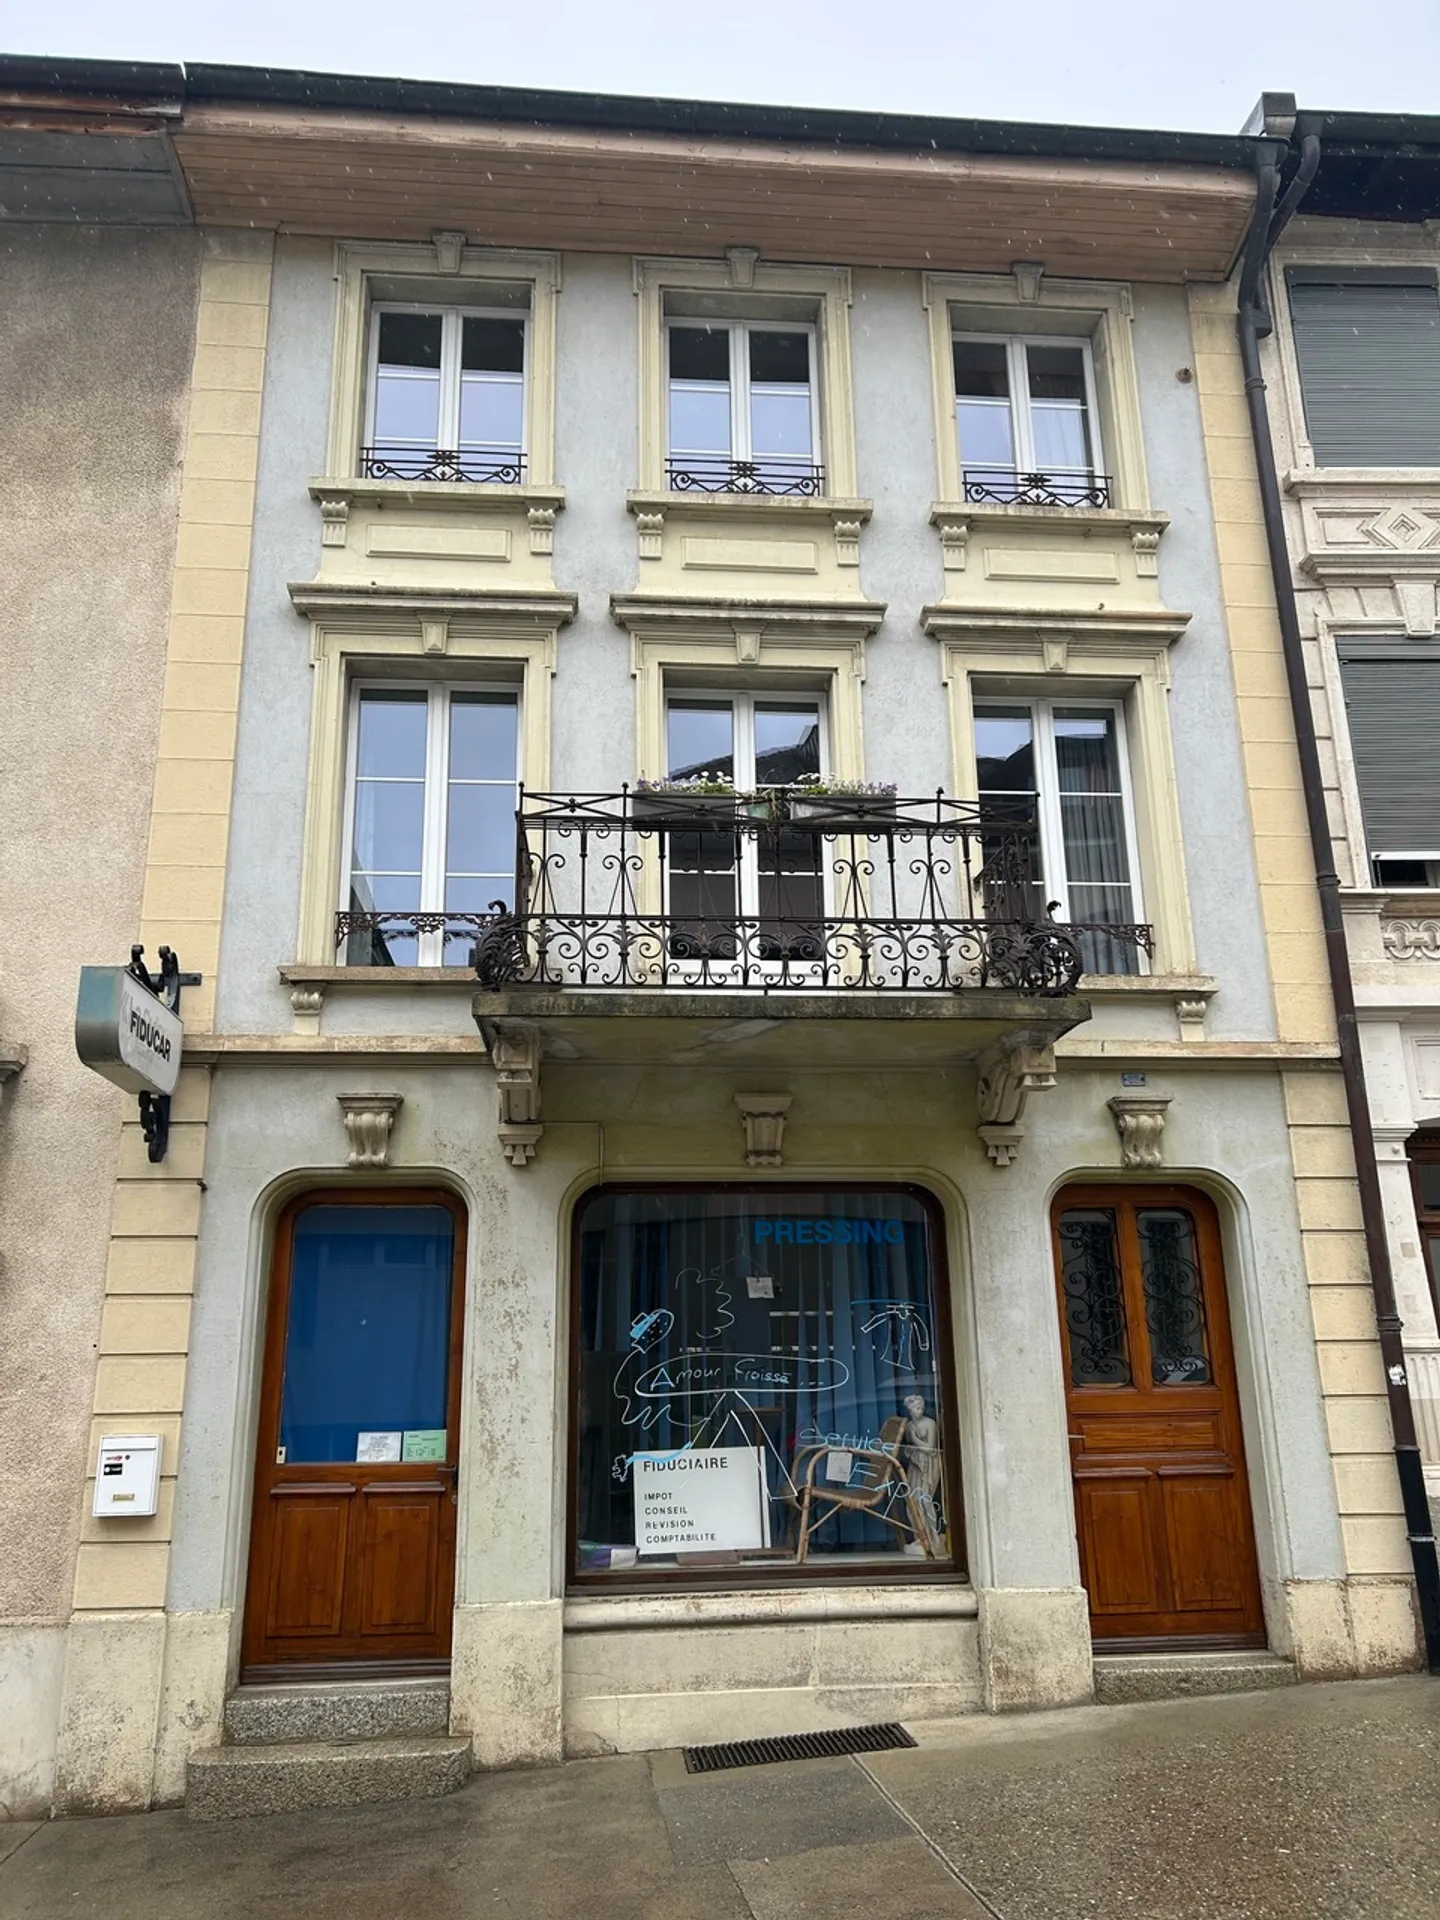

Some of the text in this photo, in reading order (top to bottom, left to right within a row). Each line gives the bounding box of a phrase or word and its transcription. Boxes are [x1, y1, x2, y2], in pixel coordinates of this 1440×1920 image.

[130, 1010, 171, 1063] FIDUCAR
[754, 1219, 905, 1245] PRESSING
[650, 1367, 721, 1391] Amour
[799, 1428, 897, 1454] Service
[643, 1456, 729, 1472] FIDUCIAIRE
[644, 1492, 673, 1501] IMPOT
[645, 1506, 688, 1515] CONSEIL
[645, 1519, 695, 1530] REVISION
[646, 1532, 717, 1544] COMPTABILITE
